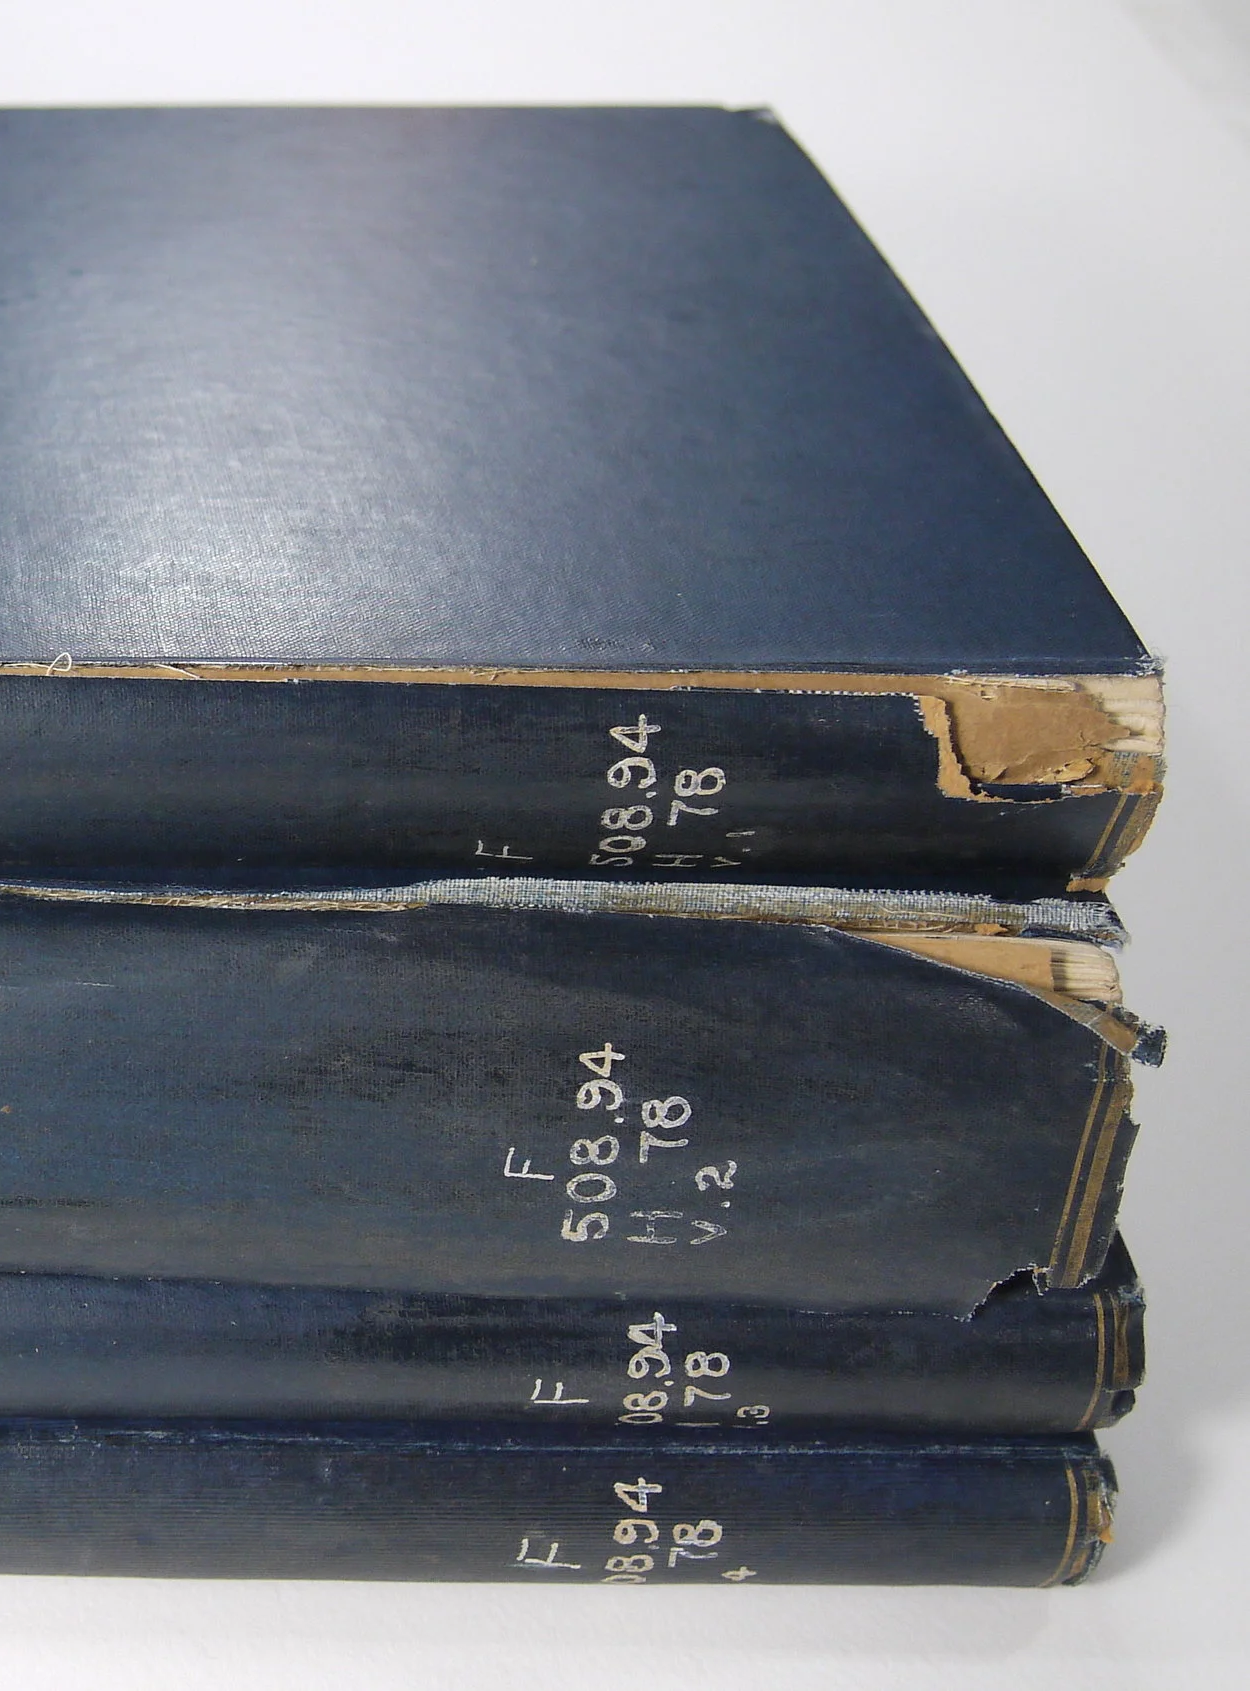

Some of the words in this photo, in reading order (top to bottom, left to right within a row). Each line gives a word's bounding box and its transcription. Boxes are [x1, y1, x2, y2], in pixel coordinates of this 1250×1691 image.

[665, 767, 727, 826] 78
[475, 839, 534, 860] F
[560, 1042, 625, 1242] 508.94
[639, 1095, 692, 1164] 78
[503, 1147, 555, 1180] F
[626, 1210, 684, 1245] H
[530, 1378, 590, 1404] F
[616, 1311, 677, 1425] 08.94
[684, 1351, 732, 1407] 78
[516, 1538, 581, 1569] F
[667, 1519, 723, 1567] 78
